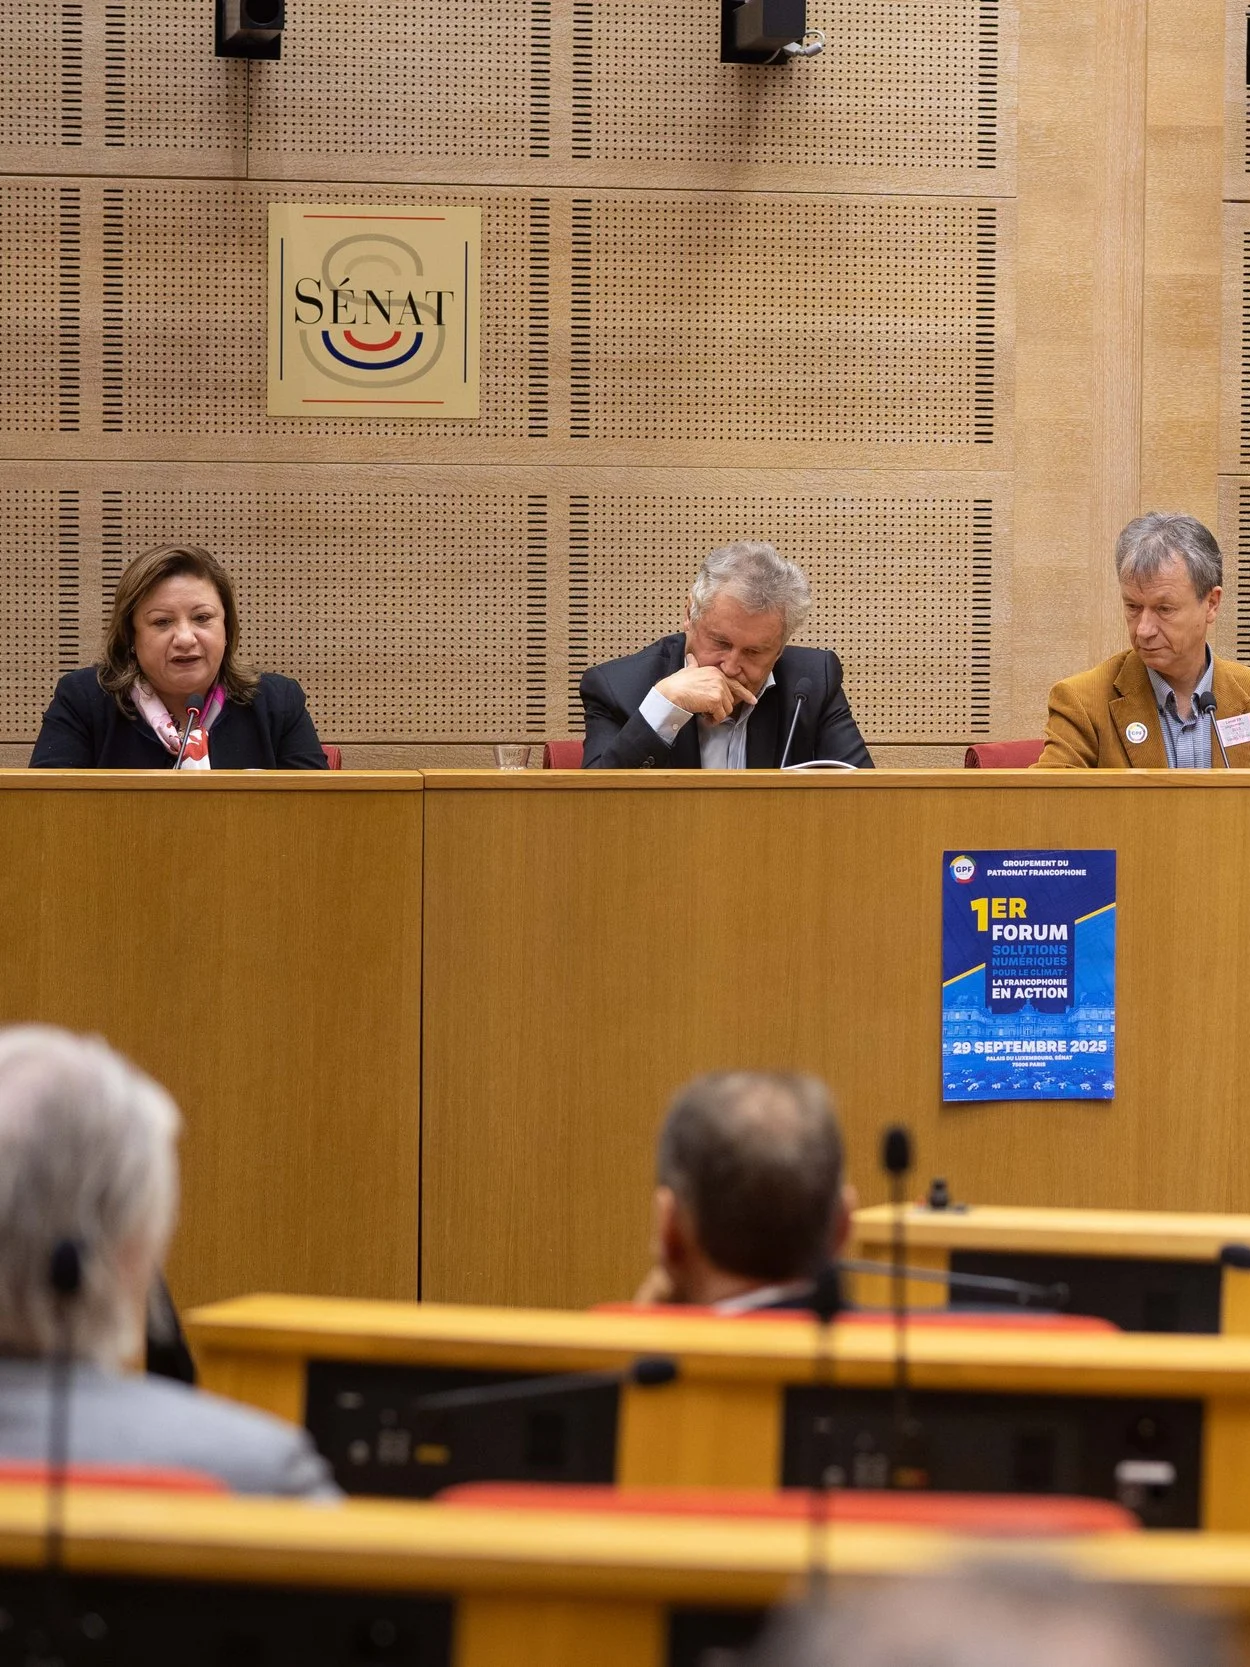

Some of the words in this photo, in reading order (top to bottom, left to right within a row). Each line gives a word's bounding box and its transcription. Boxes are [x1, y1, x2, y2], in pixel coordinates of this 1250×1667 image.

[294, 277, 454, 326] SÉNAT
[970, 897, 1027, 932] 1ER
[992, 924, 1068, 941] FORUM
[992, 945, 1068, 955] SOLUTIONS
[992, 954, 1068, 967] NUMÉRIQUES
[992, 987, 1011, 999] EN
[1014, 987, 1068, 999] ACTION
[952, 1041, 971, 1054] 29
[974, 1040, 1067, 1053] SEPTEMBRE
[1070, 1040, 1107, 1052] 2025
